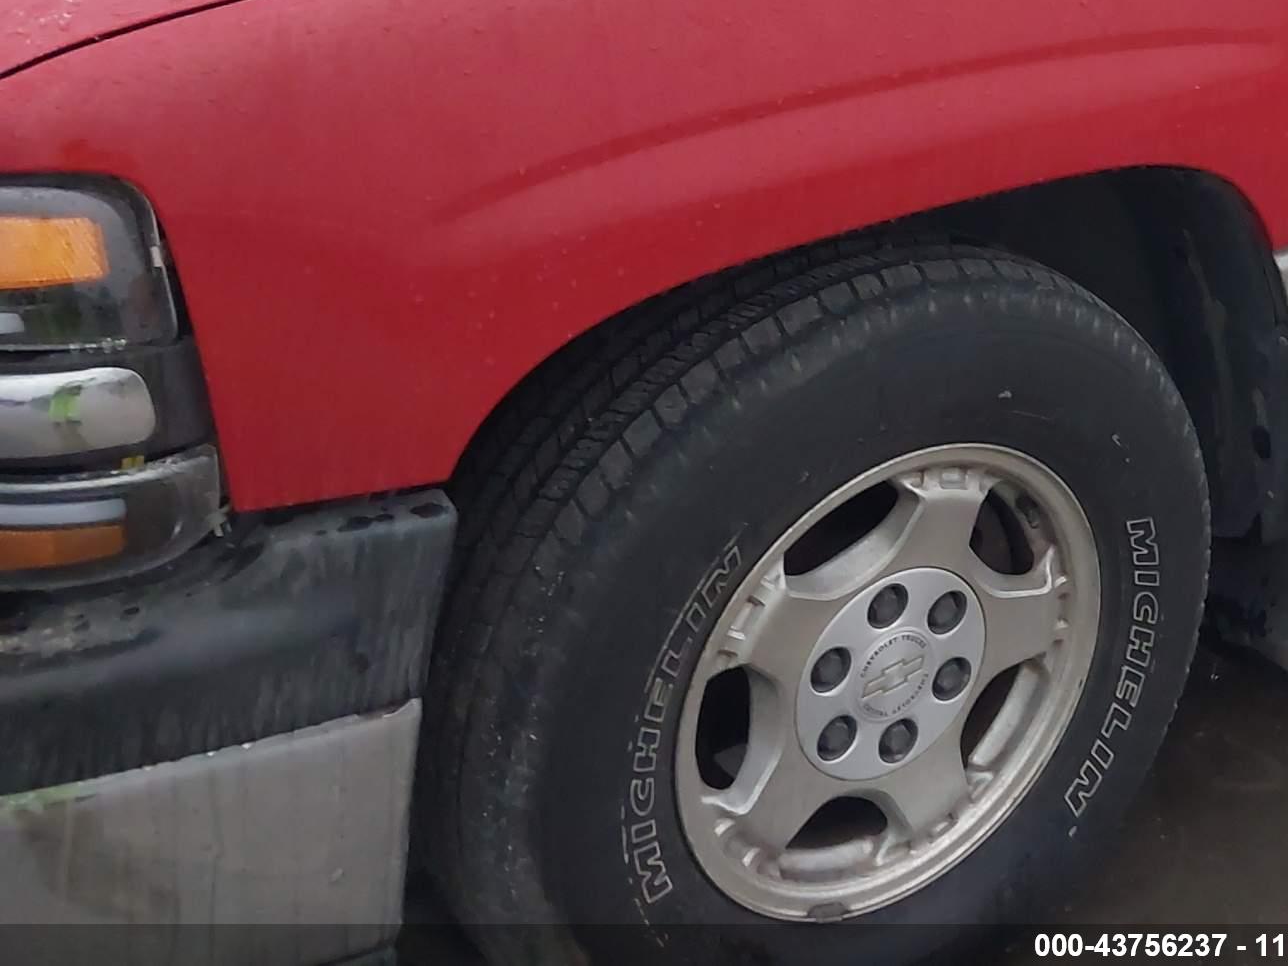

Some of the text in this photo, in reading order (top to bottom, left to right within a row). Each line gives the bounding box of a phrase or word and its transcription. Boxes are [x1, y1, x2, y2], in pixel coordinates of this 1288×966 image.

[631, 546, 741, 904] MICHELIN
[860, 636, 898, 678] CHEVROLET
[1065, 518, 1159, 817] MICHELIN
